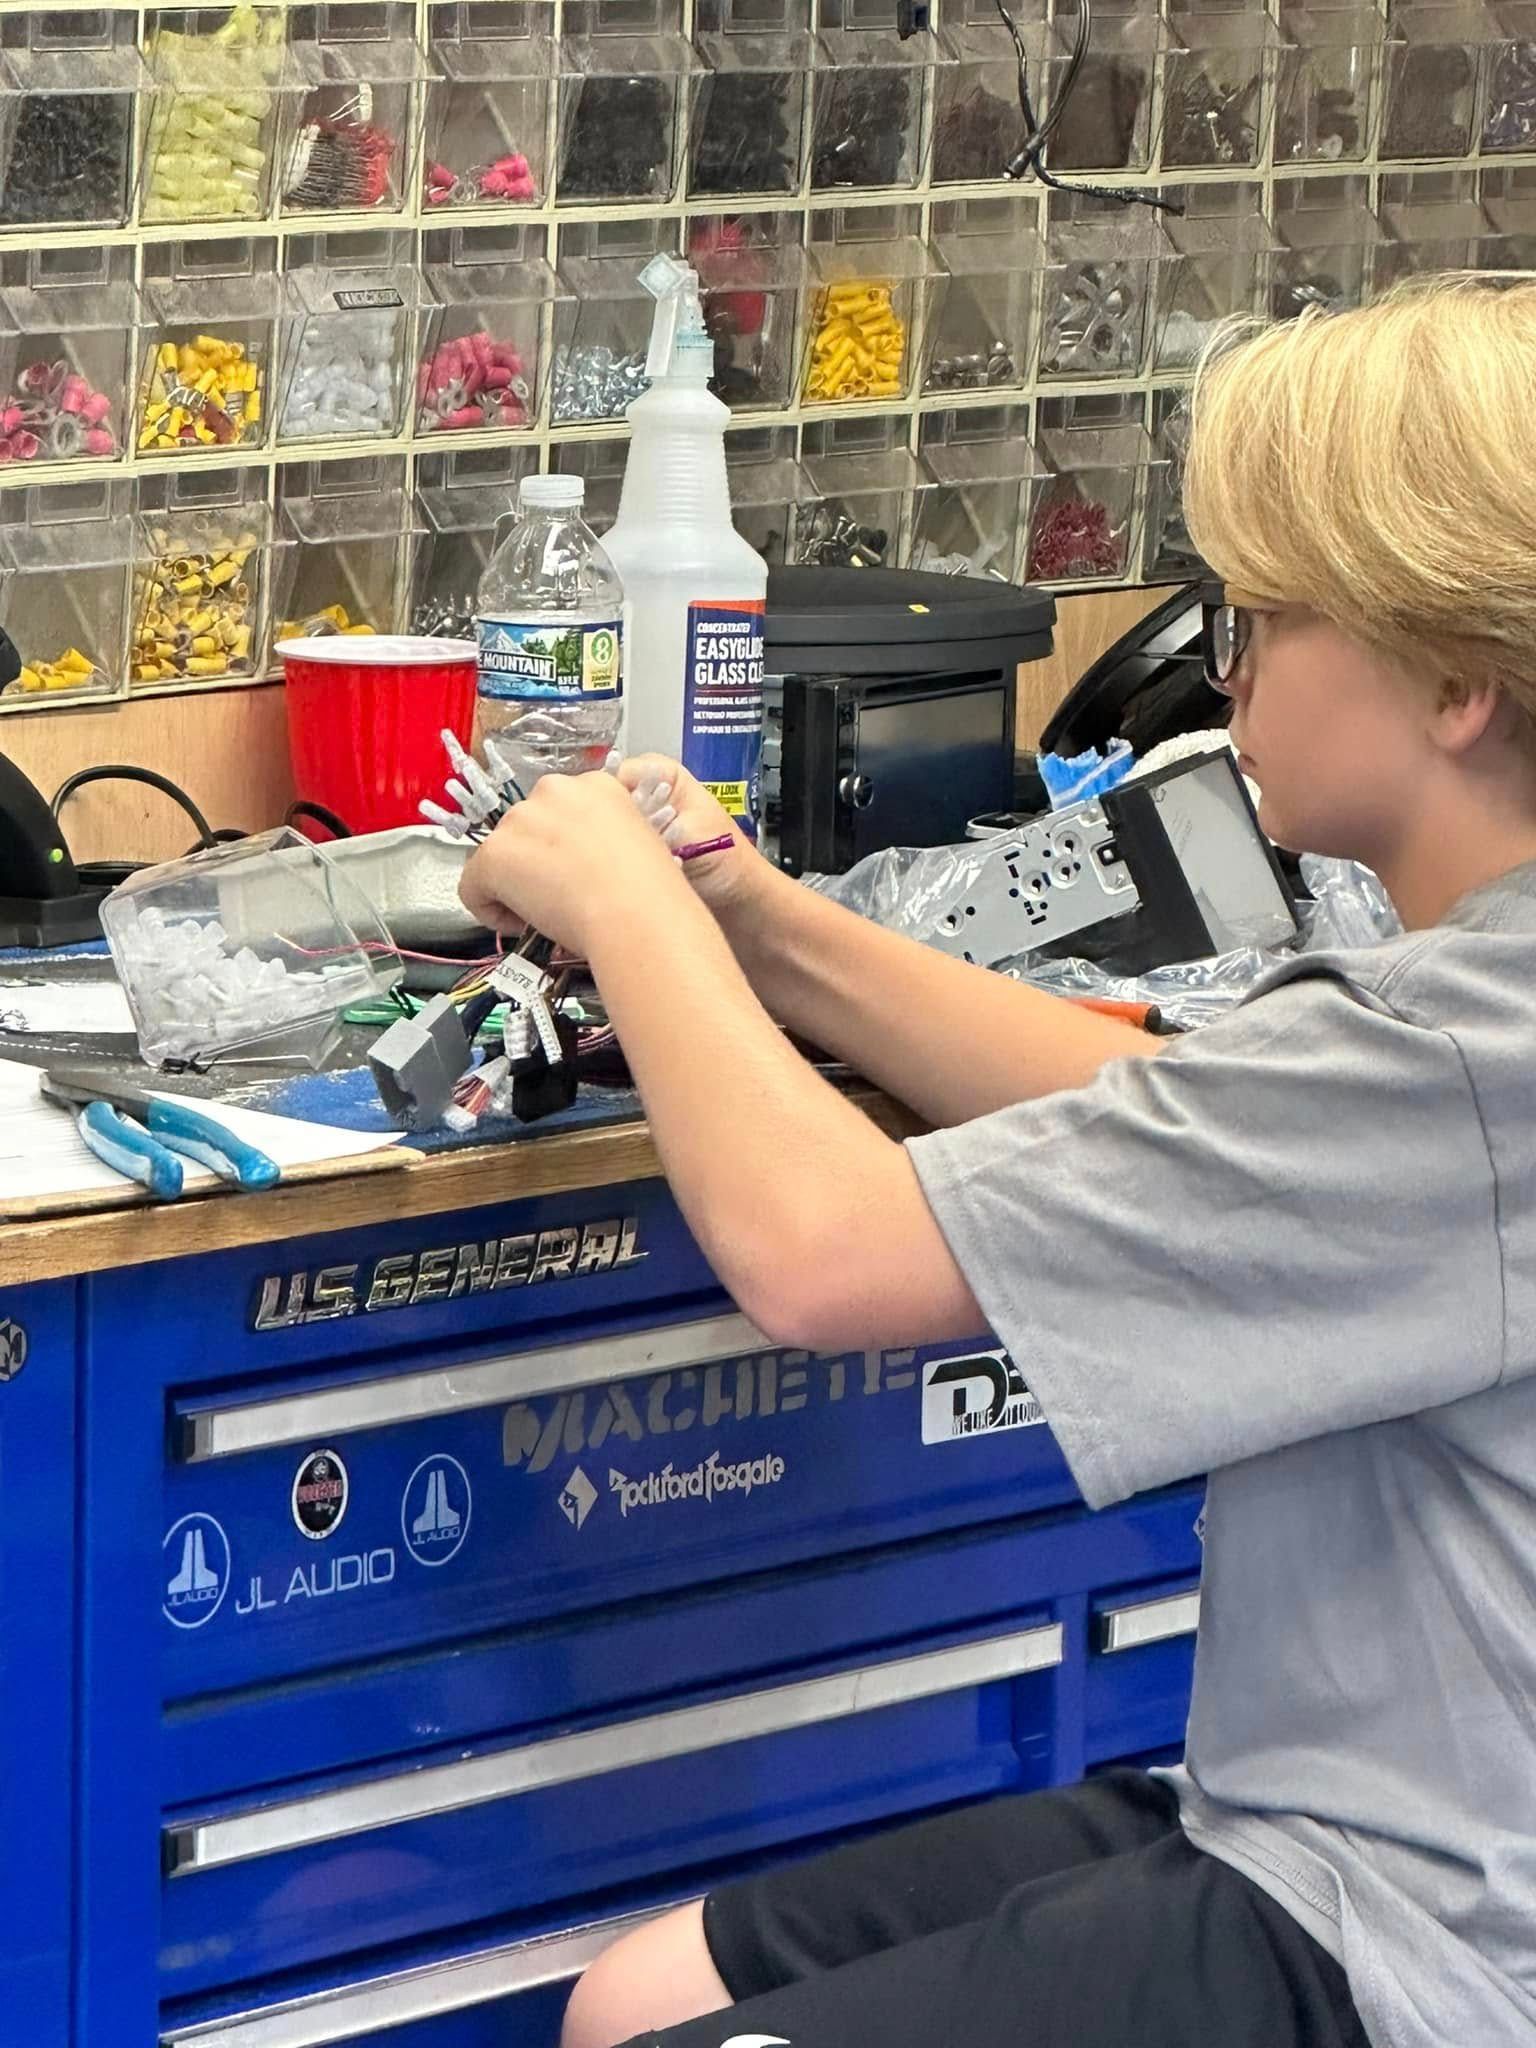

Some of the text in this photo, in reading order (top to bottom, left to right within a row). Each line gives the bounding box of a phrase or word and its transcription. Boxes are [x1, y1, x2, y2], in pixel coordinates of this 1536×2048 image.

[483, 651, 552, 680] MOUNTAIN
[695, 662, 746, 685] GLASS
[365, 1217, 650, 1312] GENERAL
[503, 1347, 917, 1473] MACHETE
[609, 1450, 785, 1518] Rockford Fosgate
[183, 1587, 219, 1604] AUDIO
[235, 1548, 395, 1614] JL AUDIO
